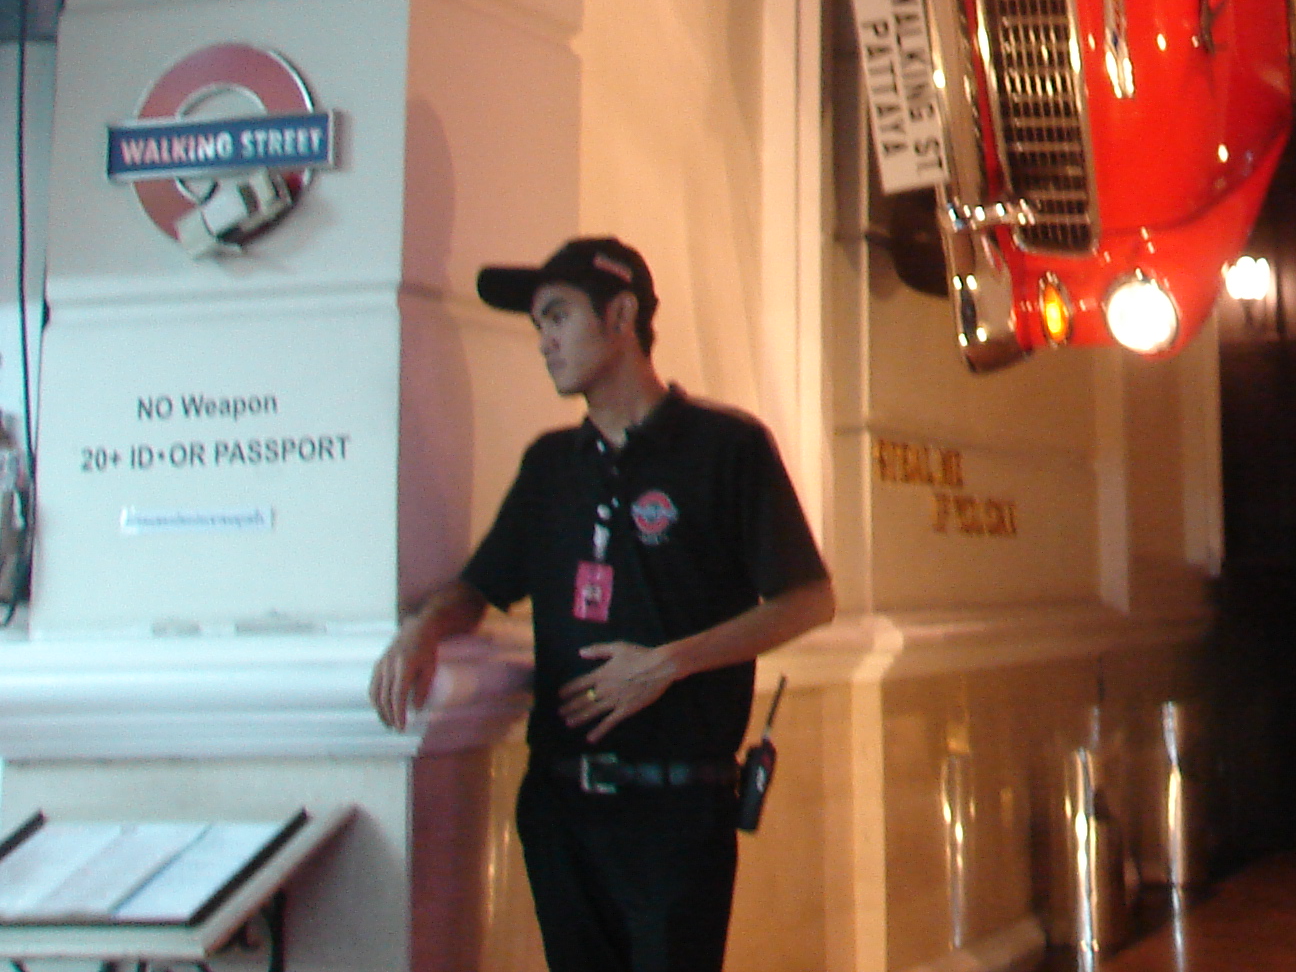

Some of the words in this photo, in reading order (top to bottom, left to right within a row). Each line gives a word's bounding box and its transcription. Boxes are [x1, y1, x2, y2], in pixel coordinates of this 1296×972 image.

[862, 18, 908, 159] PATTAYA
[120, 129, 232, 166] WALKING
[240, 125, 324, 160] STREET
[136, 395, 173, 422] NO
[180, 391, 279, 422] Weapon
[80, 445, 123, 474] 20+
[214, 435, 351, 466] PASSPORT
